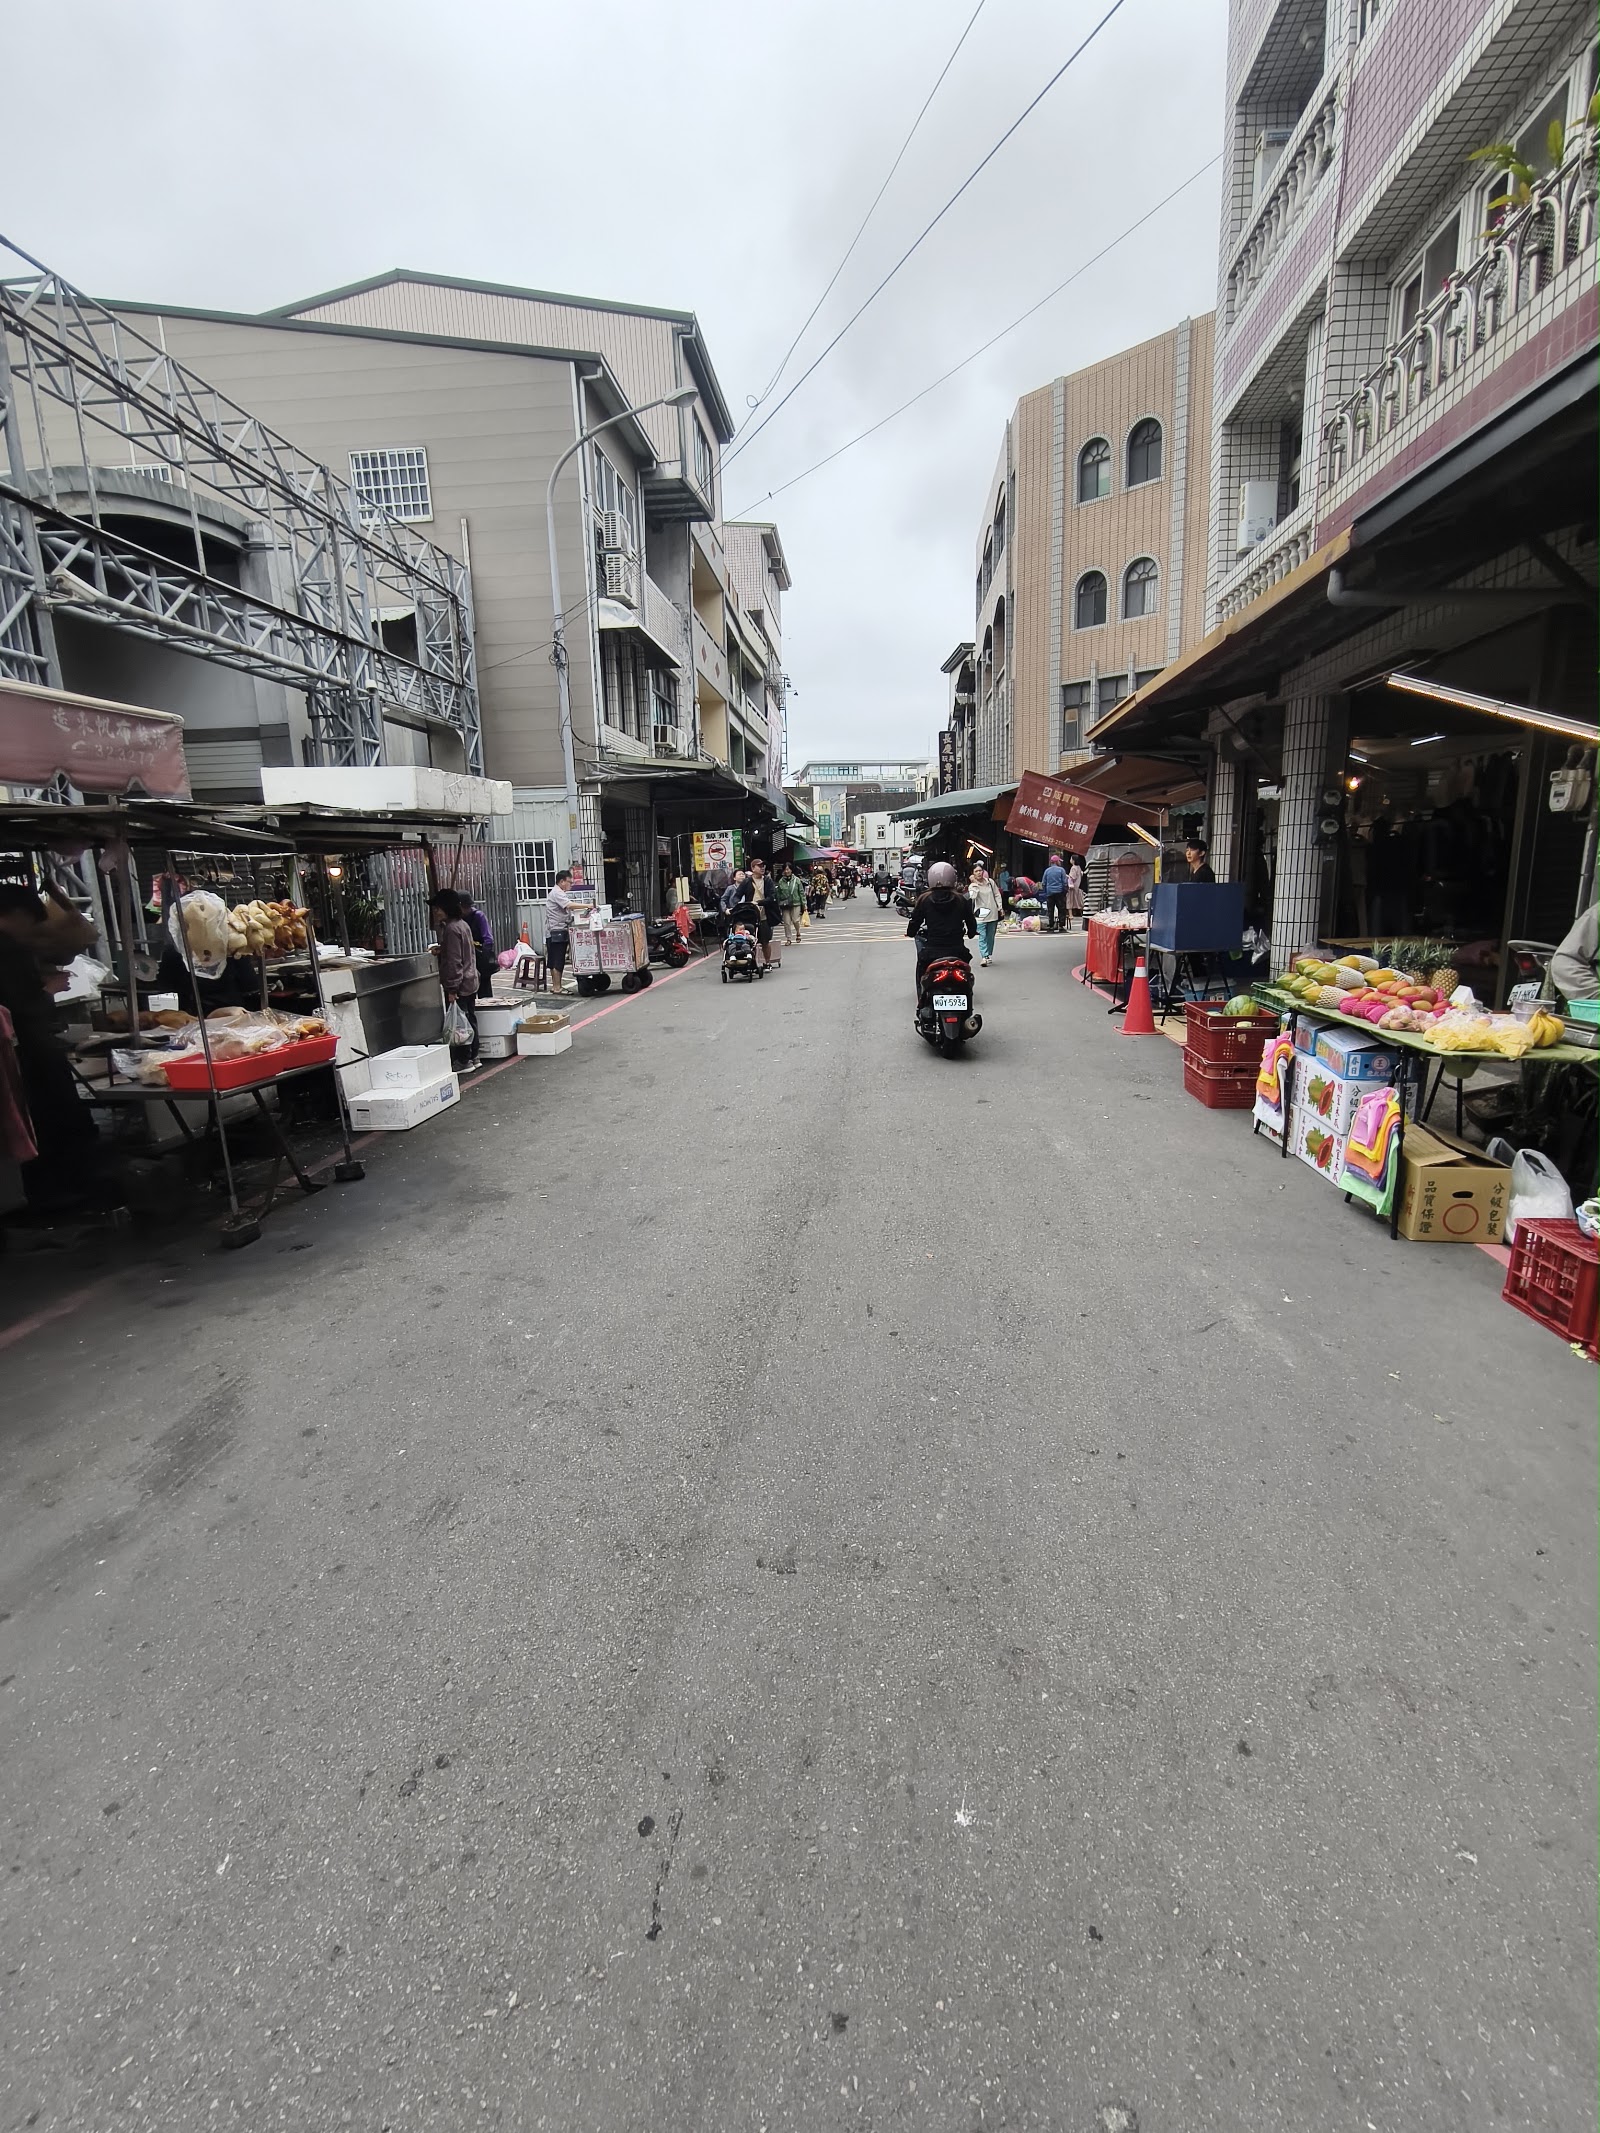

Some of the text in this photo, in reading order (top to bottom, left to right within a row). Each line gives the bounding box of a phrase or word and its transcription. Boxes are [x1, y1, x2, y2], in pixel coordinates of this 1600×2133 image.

[1419, 1181, 1438, 1234] 品質保證
[1487, 1182, 1505, 1236] 分級包裝
